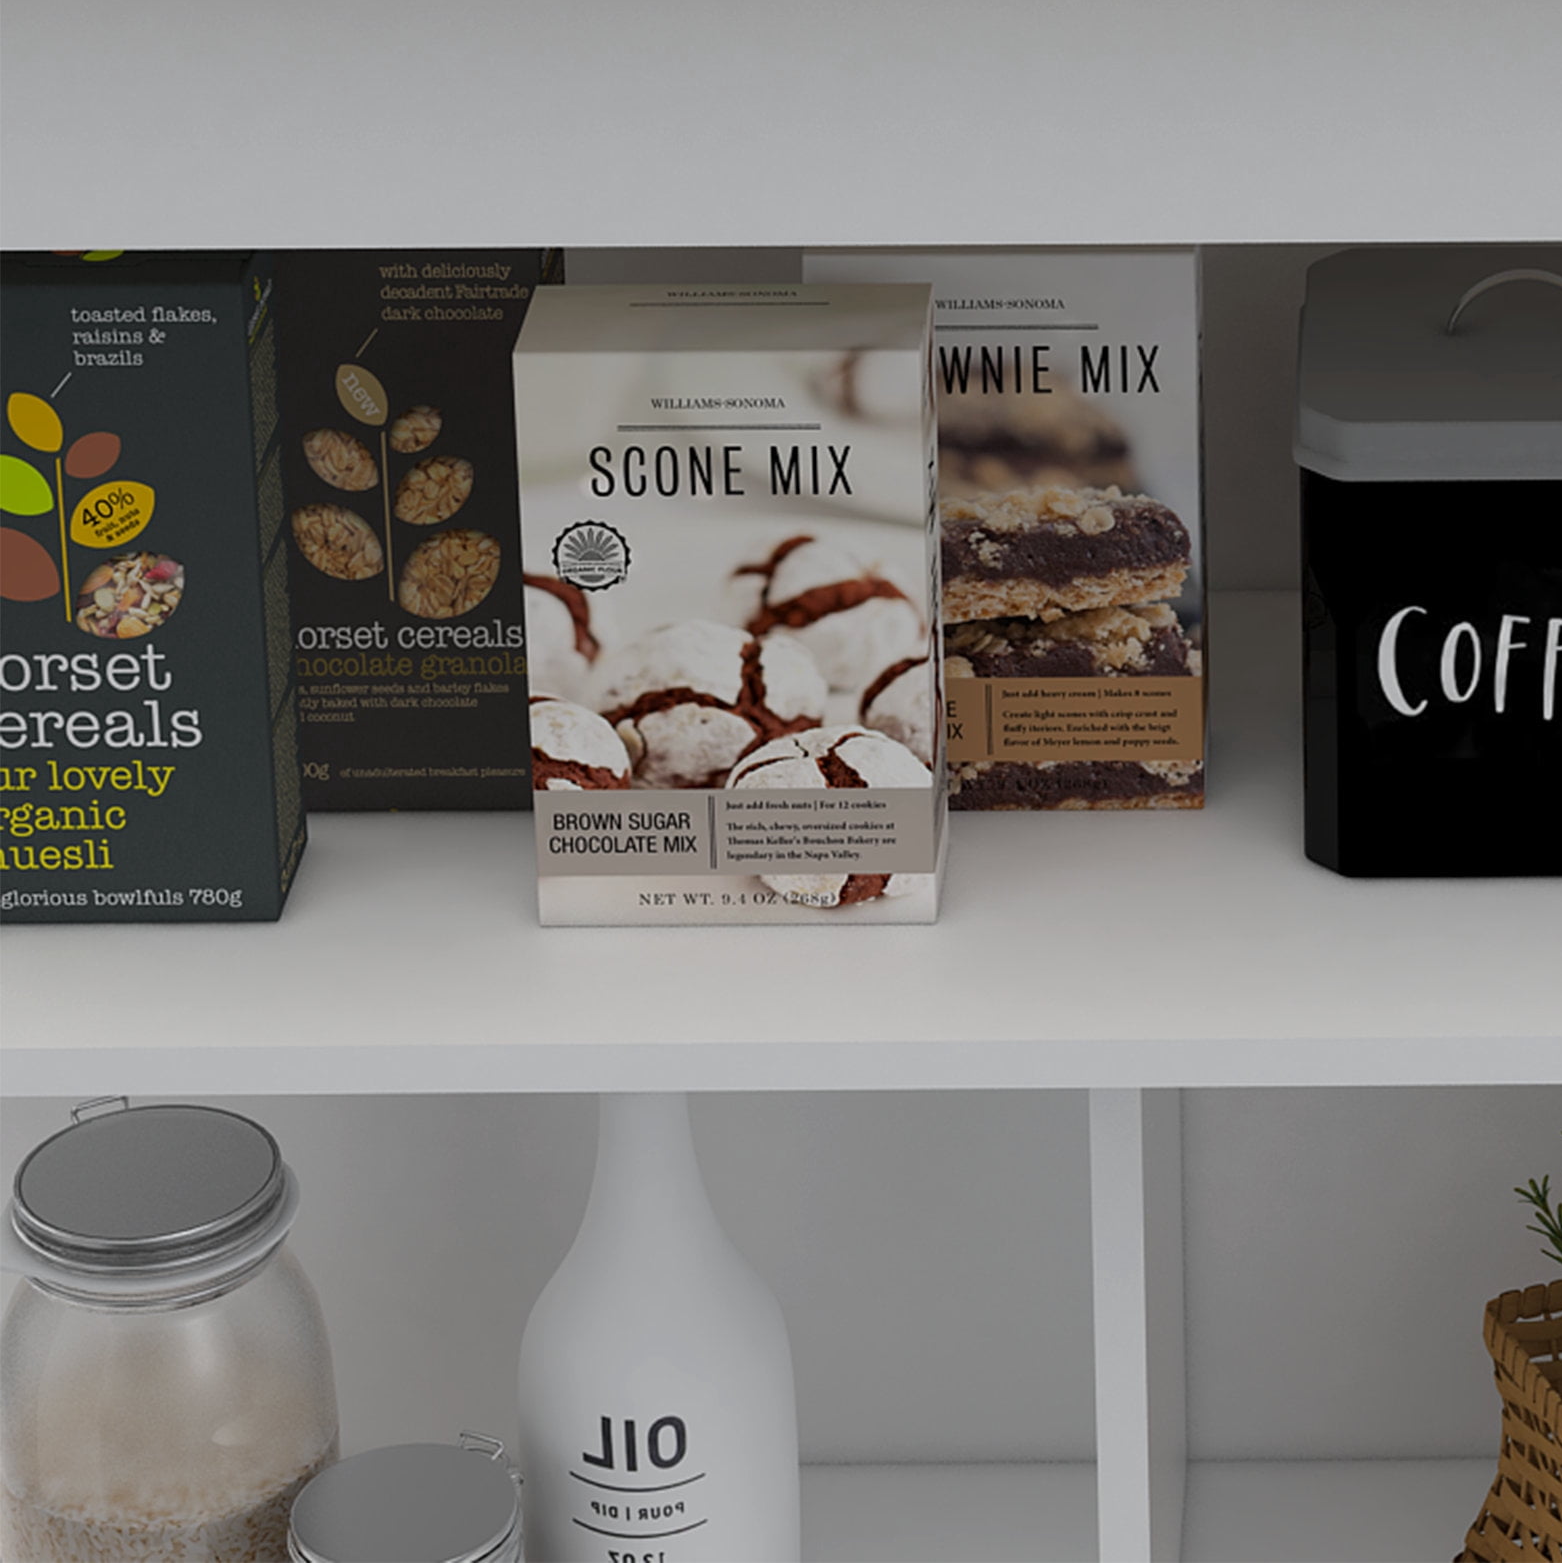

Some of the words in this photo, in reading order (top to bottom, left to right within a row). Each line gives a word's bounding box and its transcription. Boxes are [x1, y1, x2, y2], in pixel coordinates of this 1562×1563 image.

[379, 264, 418, 279] with
[421, 263, 512, 280] deliciously
[380, 284, 453, 300] decadent
[454, 284, 529, 300] Fairtrade
[71, 306, 146, 323] toasted
[152, 306, 217, 324] flakes,
[381, 306, 421, 320] dark
[424, 306, 504, 320] chocolate
[72, 328, 143, 345] raisins
[148, 328, 166, 344] &
[73, 350, 144, 366] brazils
[1081, 345, 1160, 394] MIX
[341, 371, 381, 416] new
[588, 445, 745, 497] SCONE
[769, 445, 853, 496] MIX
[82, 487, 135, 528] 40%
[295, 621, 388, 650] orset
[398, 619, 524, 650] cereals
[420, 652, 528, 681] granola
[47, 760, 176, 797] lovely
[553, 812, 622, 831] BROWN
[628, 812, 691, 831] SUGAR
[549, 835, 658, 854] CHOCOLATE
[663, 835, 697, 854] MIX
[0, 839, 114, 871] uesli
[1, 890, 88, 910] glorious
[92, 888, 184, 907] bowlfuls
[189, 888, 243, 909] 780g
[639, 893, 677, 906] NET
[683, 893, 715, 906] WT.
[753, 892, 778, 906] OZ
[783, 892, 837, 908] (268g)
